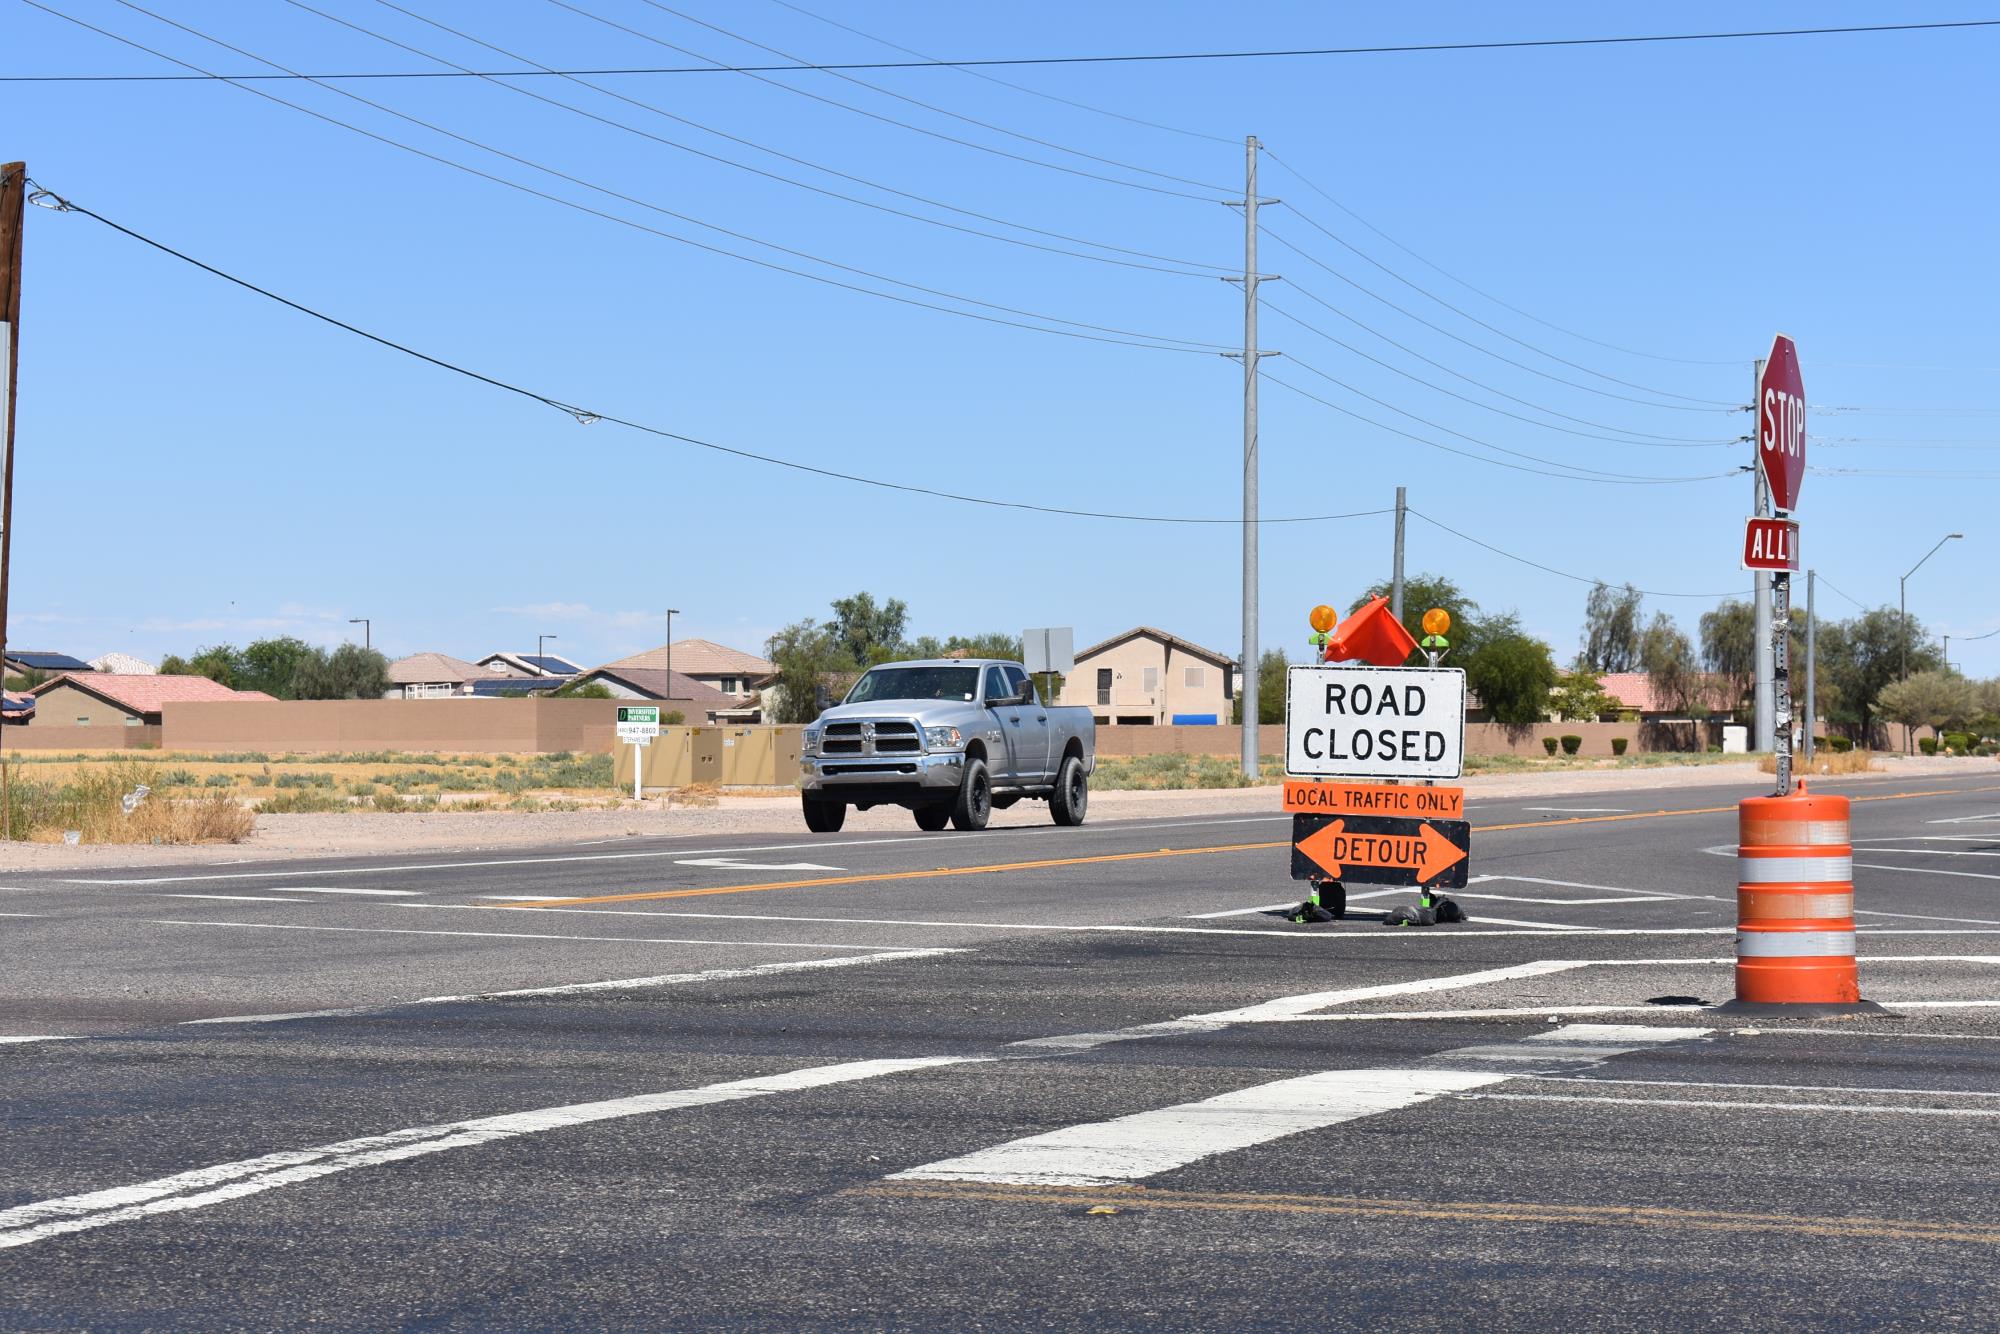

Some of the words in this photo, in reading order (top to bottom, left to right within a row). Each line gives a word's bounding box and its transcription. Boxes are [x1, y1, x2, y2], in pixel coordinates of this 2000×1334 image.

[1764, 388, 1804, 458] STOP
[1751, 528, 1787, 560] ALL
[1325, 683, 1426, 717] ROAD
[1303, 727, 1446, 762] CLOSED
[1286, 788, 1338, 807] LOCAL
[1345, 791, 1409, 810] TRAFFIC
[1416, 793, 1459, 811] ONLY
[1333, 836, 1428, 865] DETOUR
